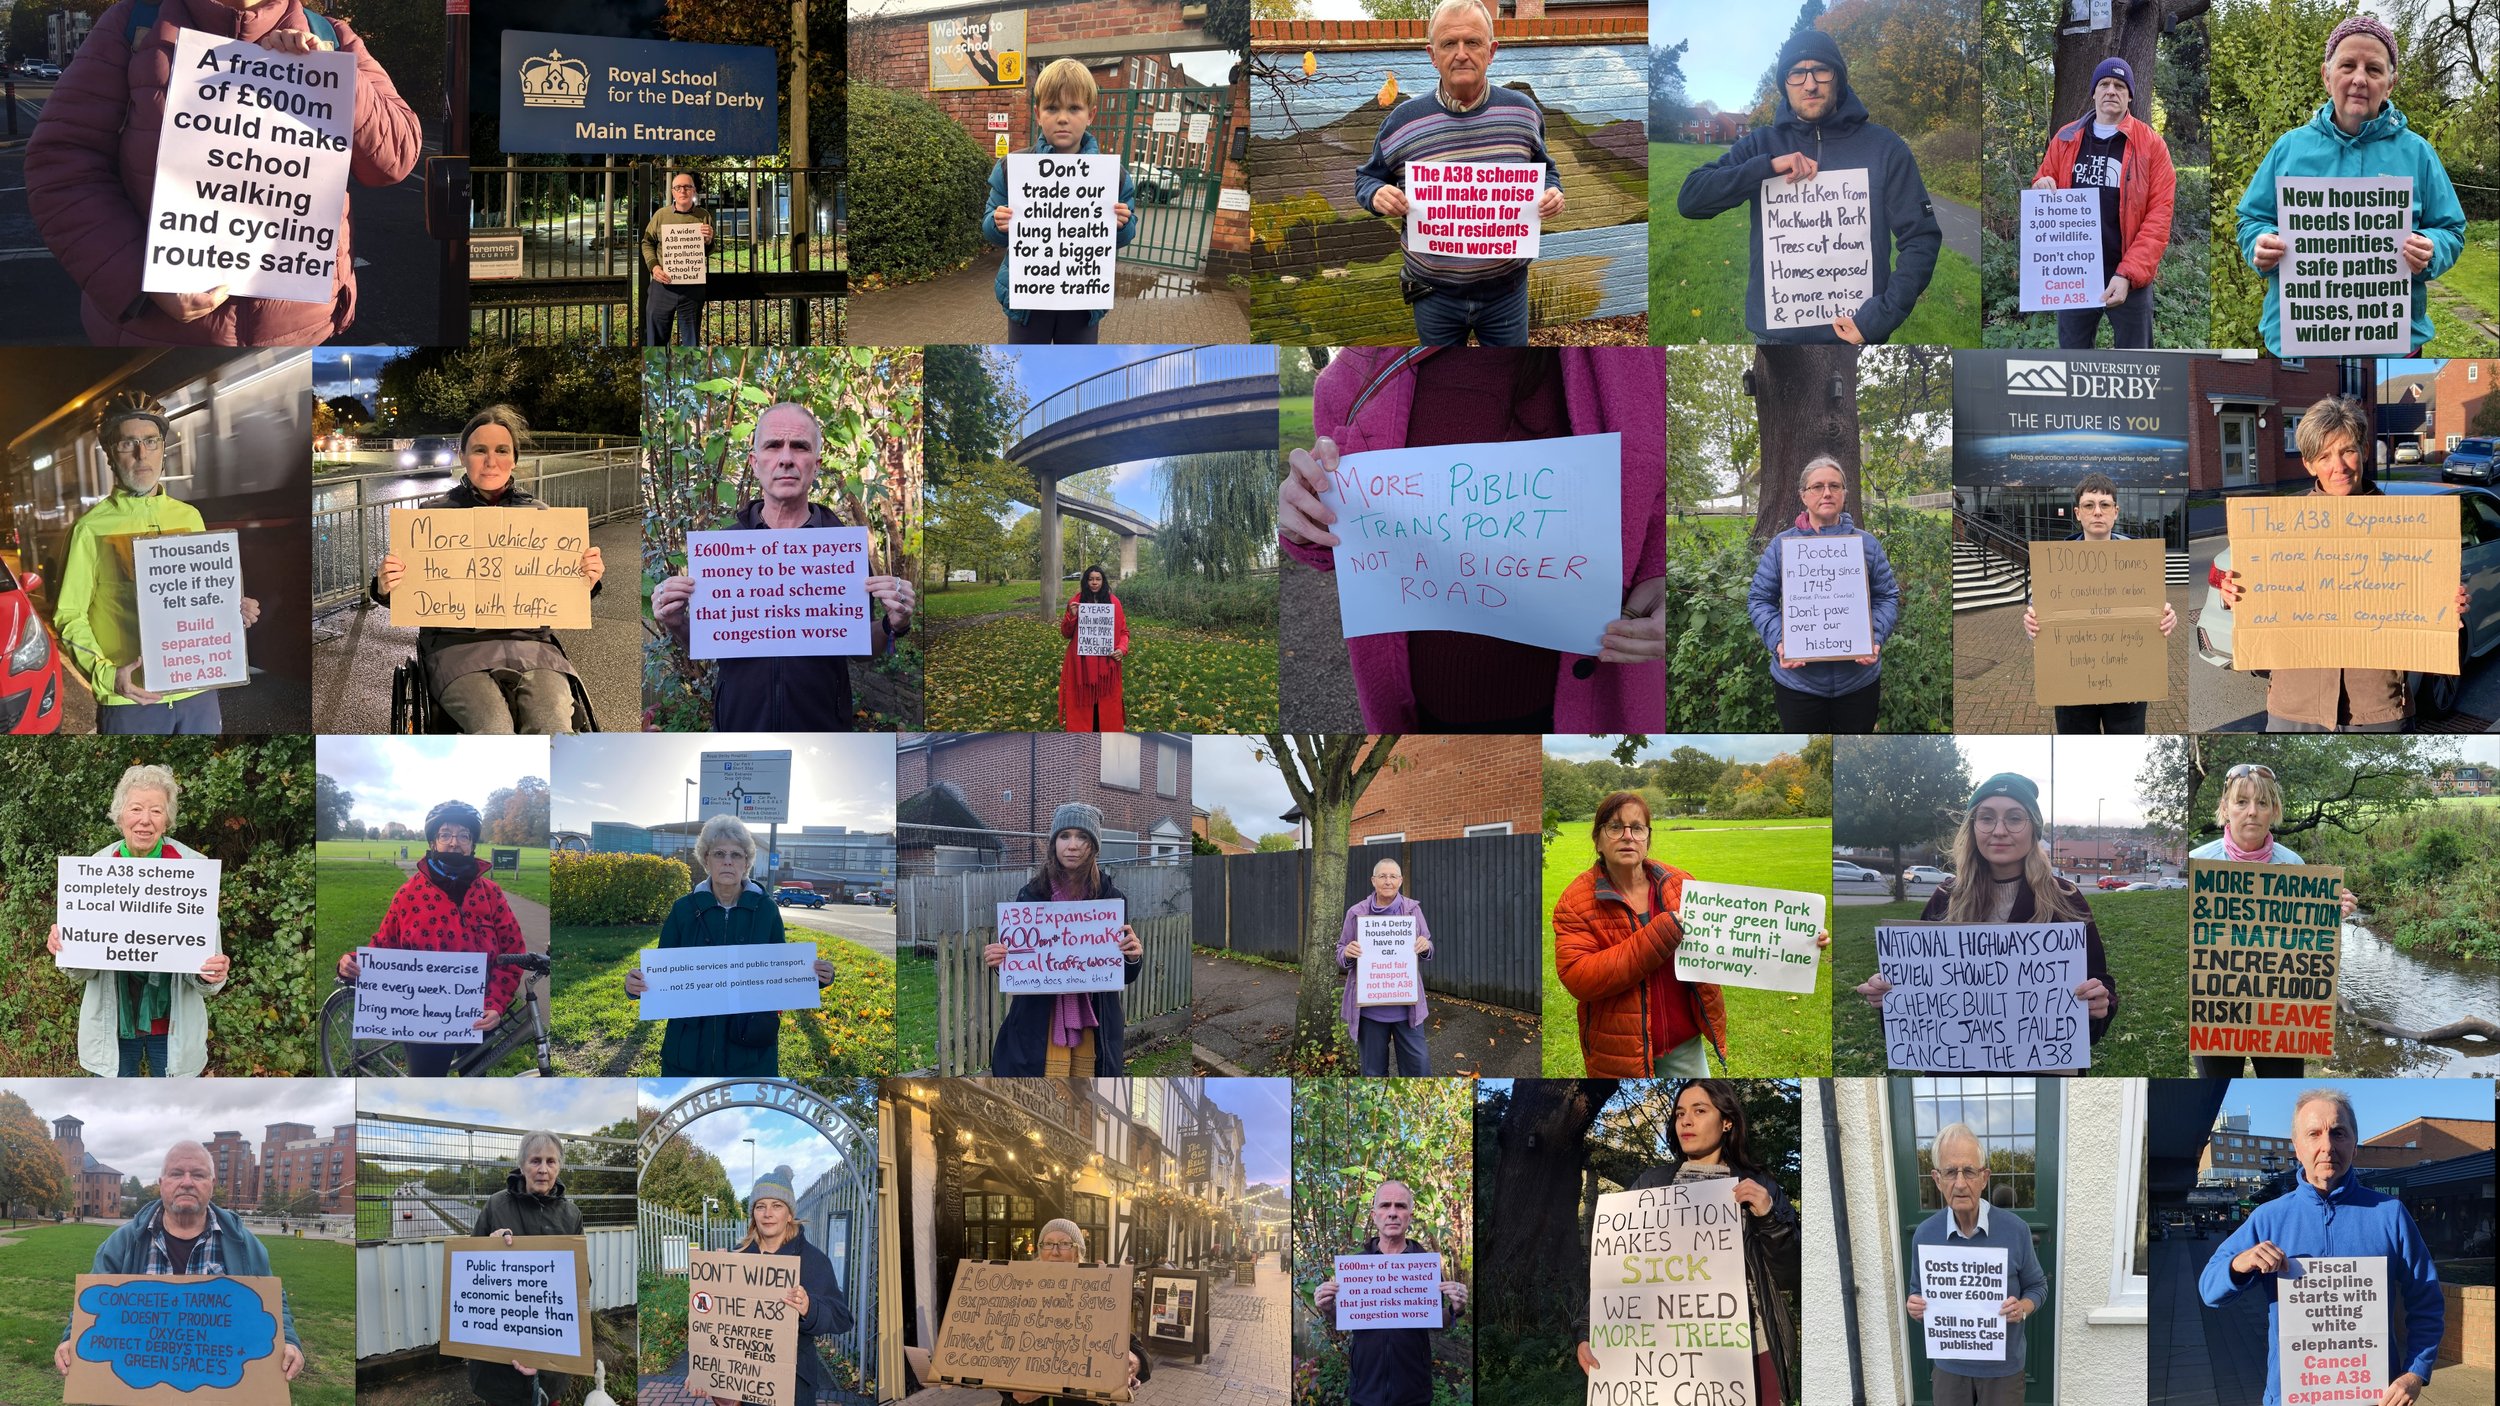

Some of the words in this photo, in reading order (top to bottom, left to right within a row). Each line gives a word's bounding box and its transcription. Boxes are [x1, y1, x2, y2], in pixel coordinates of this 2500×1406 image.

[934, 21, 987, 38] Welcome
[991, 20, 1003, 31] to
[935, 46, 952, 55] our
[956, 35, 992, 53] school
[197, 49, 220, 72] A
[229, 54, 338, 88] fraction
[609, 67, 656, 86] Royal
[662, 70, 717, 86] School
[198, 81, 231, 102] of
[237, 84, 332, 120] £600m
[608, 87, 633, 102] for
[639, 88, 666, 103] the
[672, 91, 711, 105] Deaf
[716, 92, 764, 110] Derby
[576, 122, 626, 139] Main
[634, 124, 716, 141] Entrance
[1039, 159, 1089, 177] Don't
[1412, 166, 1440, 181] The
[1443, 166, 1472, 182] A38
[1477, 167, 1538, 183] scheme
[2076, 173, 2103, 186] FACE
[2283, 187, 2324, 207] New
[2329, 188, 2409, 209] housing
[1024, 201, 1102, 218] children's
[1768, 209, 1832, 228] Mackworth
[1837, 206, 1866, 226] Park
[2030, 220, 2056, 230] 3,000
[2059, 219, 2096, 231] species
[2036, 232, 2046, 243] of
[2050, 231, 2092, 242] wildlife.
[152, 245, 250, 270] routes
[260, 252, 334, 277] safer
[1771, 260, 1814, 279] Homes
[1816, 260, 1868, 282] exposed
[2296, 324, 2350, 342] wider
[2355, 322, 2398, 341] road
[2070, 362, 2143, 375] UNIVERSITY
[2146, 365, 2160, 375] OF
[2071, 375, 2160, 400] DERBY
[2008, 413, 2038, 428] THE
[2045, 415, 2102, 430] FUTURE
[2108, 416, 2121, 430] IS
[2126, 417, 2160, 431] YOU
[2010, 454, 2033, 462] Making
[2241, 506, 2286, 533] The
[2294, 510, 2330, 532] A38
[2345, 512, 2428, 536] expansion
[411, 516, 471, 549] More
[488, 524, 548, 548] vehicles
[557, 536, 581, 550] on
[149, 540, 230, 558] Thousands
[1798, 544, 1848, 559] Rooted
[702, 567, 753, 580] money
[758, 565, 774, 576] to
[779, 562, 795, 576] be
[801, 560, 855, 575] wasted
[2046, 547, 2108, 575] 130,000
[2113, 552, 2148, 571] tonnes
[1401, 577, 1506, 608] ROAD
[1803, 580, 1832, 592] 1745
[2254, 583, 2305, 593] around
[2319, 579, 2406, 591] Mickleover
[176, 618, 214, 632] Build
[1806, 638, 1852, 652] history
[66, 901, 73, 910] a
[78, 900, 115, 912] Local
[120, 901, 172, 913] Wildlife
[177, 903, 204, 914] Site
[1685, 890, 1767, 912] Markeaton
[1775, 900, 1810, 916] Park
[1001, 907, 1033, 926] A38
[1035, 907, 1117, 928] Expansion
[1389, 920, 1412, 928] Derby
[1366, 929, 1412, 937] households
[359, 953, 423, 972] Thousands
[426, 964, 479, 974] exercise
[670, 965, 694, 973] public
[746, 960, 769, 969] public
[1679, 955, 1757, 978] motorway.
[2193, 949, 2335, 977] INCREASES
[1043, 976, 1062, 985] docs
[1066, 976, 1086, 984] show
[1092, 972, 1113, 982] this!
[1368, 991, 1412, 999] expansion.
[2192, 1000, 2252, 1024] RISK!
[2258, 1003, 2332, 1029] LEAVE
[1891, 1043, 1975, 1069] CANCEL
[1981, 1045, 2015, 1068] THE
[2027, 1043, 2072, 1066] A38
[637, 1086, 733, 1163] PEARTREE
[755, 1084, 858, 1154] STATION
[1638, 1185, 1690, 1208] AIR
[1597, 1203, 1738, 1233] POLLUTION
[467, 1260, 496, 1272] Public
[502, 1260, 555, 1275] transport
[691, 1262, 737, 1283] DON'T
[743, 1265, 796, 1288] WIDEN
[1621, 1254, 1711, 1284] SICK
[1925, 1260, 1958, 1272] Costs
[1962, 1262, 2002, 1275] tripled
[2309, 1261, 2357, 1273] Fiscal
[1927, 1274, 1956, 1286] from
[1960, 1276, 2002, 1288] £220m
[178, 1312, 232, 1327] PRODUCE
[952, 1311, 981, 1323] our
[985, 1309, 1020, 1335] high
[1024, 1310, 1092, 1332] streets
[1350, 1311, 1398, 1321] congestion
[2291, 1337, 2378, 1352] elephants.
[745, 1351, 776, 1363] FIELDS
[710, 1373, 775, 1396] SERVICES
